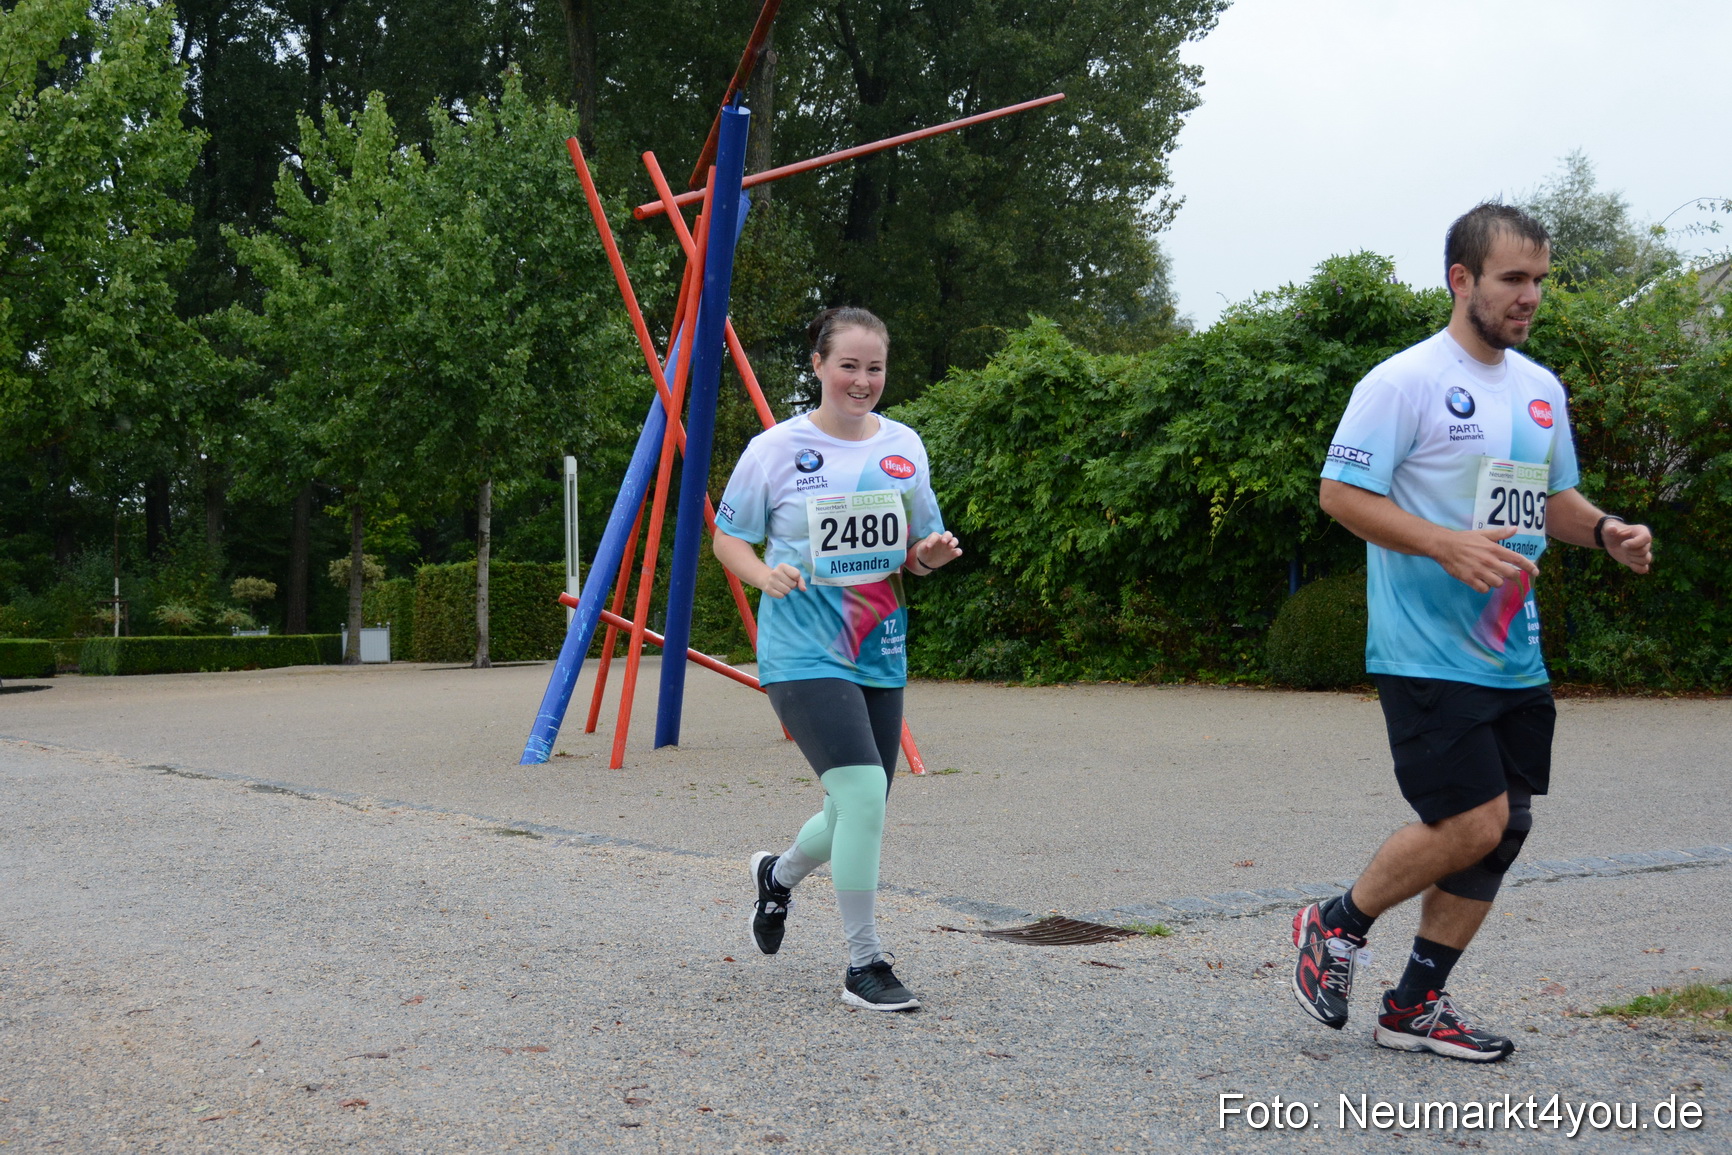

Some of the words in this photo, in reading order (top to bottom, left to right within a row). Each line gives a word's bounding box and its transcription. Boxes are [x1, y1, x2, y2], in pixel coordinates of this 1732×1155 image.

[1449, 424, 1483, 434] PARTL
[1327, 444, 1373, 466] BOCK
[884, 460, 912, 473] Hervis
[796, 476, 828, 487] PARTL
[797, 483, 828, 492] Neumarkt
[815, 503, 847, 512] NeuerMarkt
[852, 493, 896, 507] BOCK
[1487, 486, 1547, 530] 2093
[820, 512, 899, 551] 2480
[1497, 540, 1538, 555] lexander
[830, 556, 890, 574] Alexandra
[883, 619, 897, 635] 17.
[1410, 951, 1435, 967] ILA
